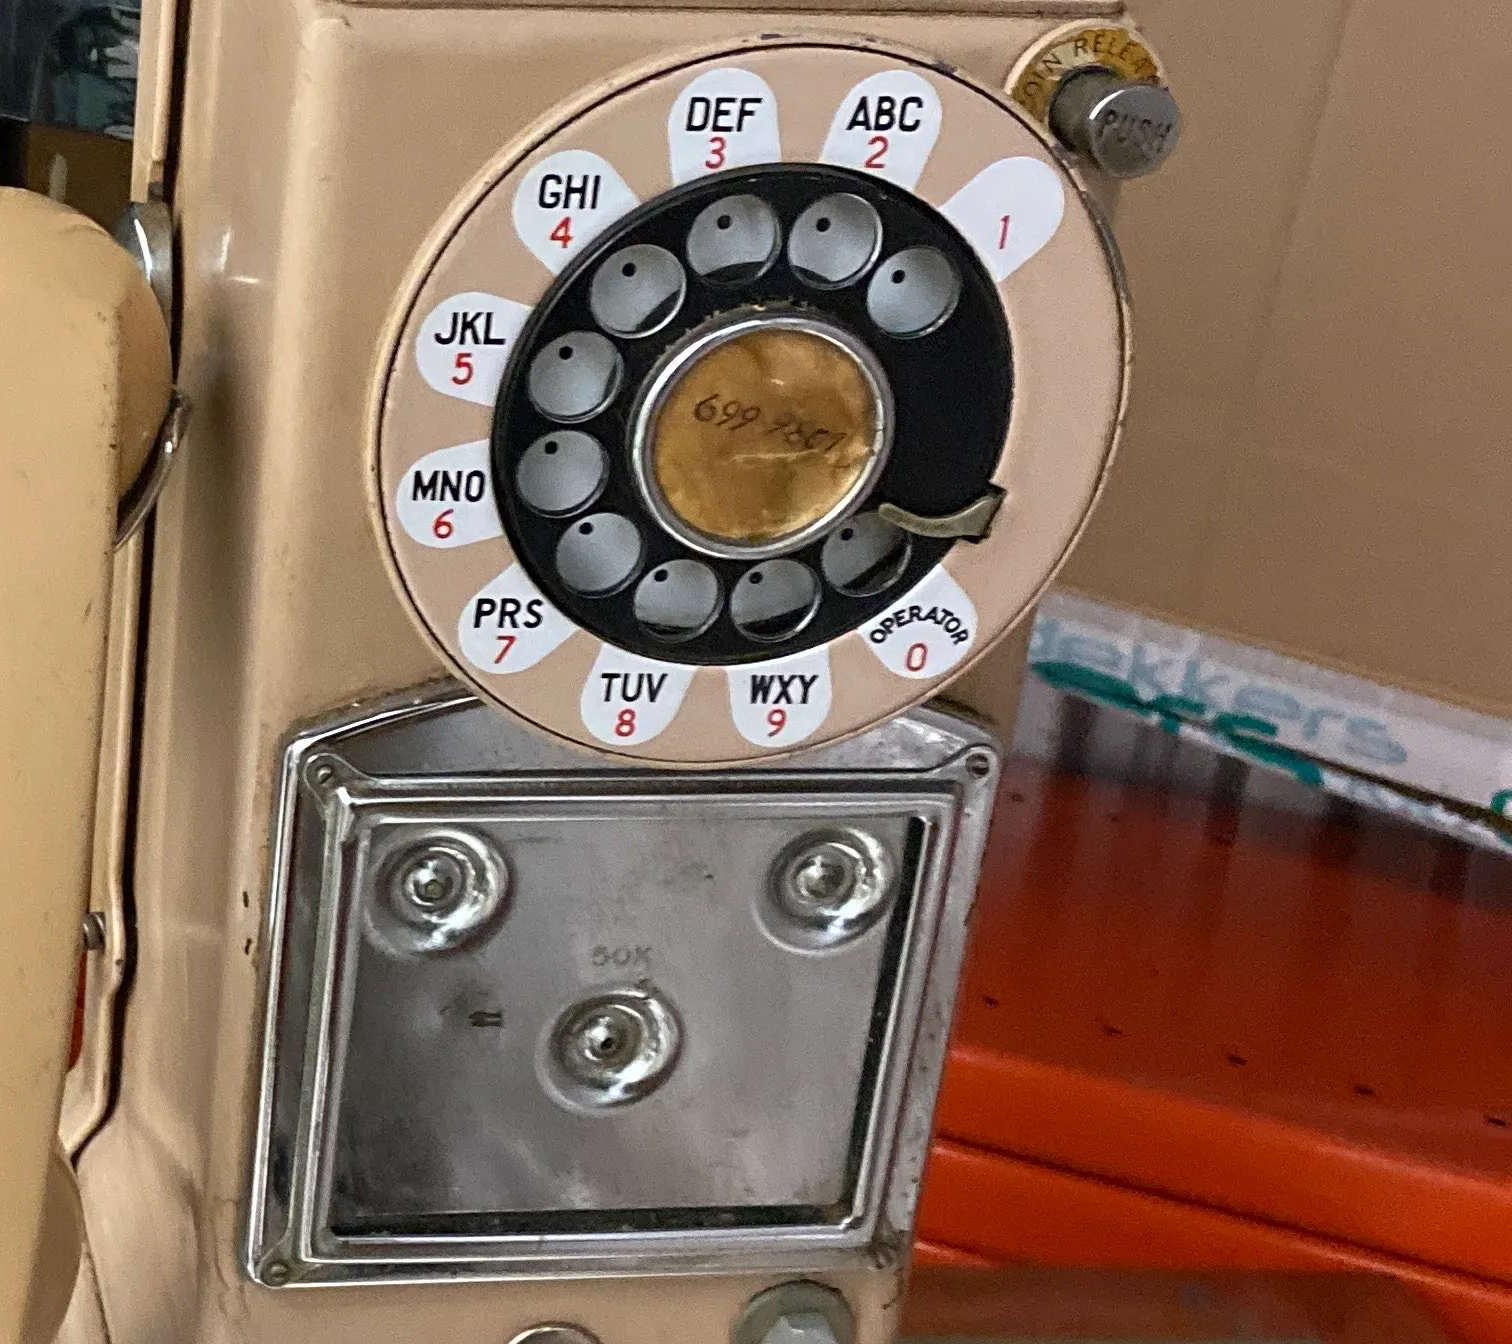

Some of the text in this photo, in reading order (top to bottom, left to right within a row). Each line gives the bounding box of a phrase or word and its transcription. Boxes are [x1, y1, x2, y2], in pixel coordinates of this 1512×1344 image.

[684, 96, 763, 133] DEF
[845, 95, 924, 133] ABC
[704, 136, 727, 170] 3
[864, 135, 889, 169] 2
[537, 173, 602, 210] GHI
[549, 216, 574, 249] 4
[998, 214, 1011, 250] 1
[434, 311, 507, 346] JKL
[451, 351, 475, 385] 5
[693, 393, 761, 432] 699
[411, 469, 486, 503] MNO
[432, 508, 455, 540] 6
[472, 597, 545, 629] PRS
[869, 604, 970, 647] OPERATOR
[494, 635, 517, 665] 7
[904, 642, 928, 672] 0
[600, 672, 669, 704] TUV
[749, 673, 820, 706] WXY
[614, 708, 636, 738] 8
[766, 708, 788, 738] 9
